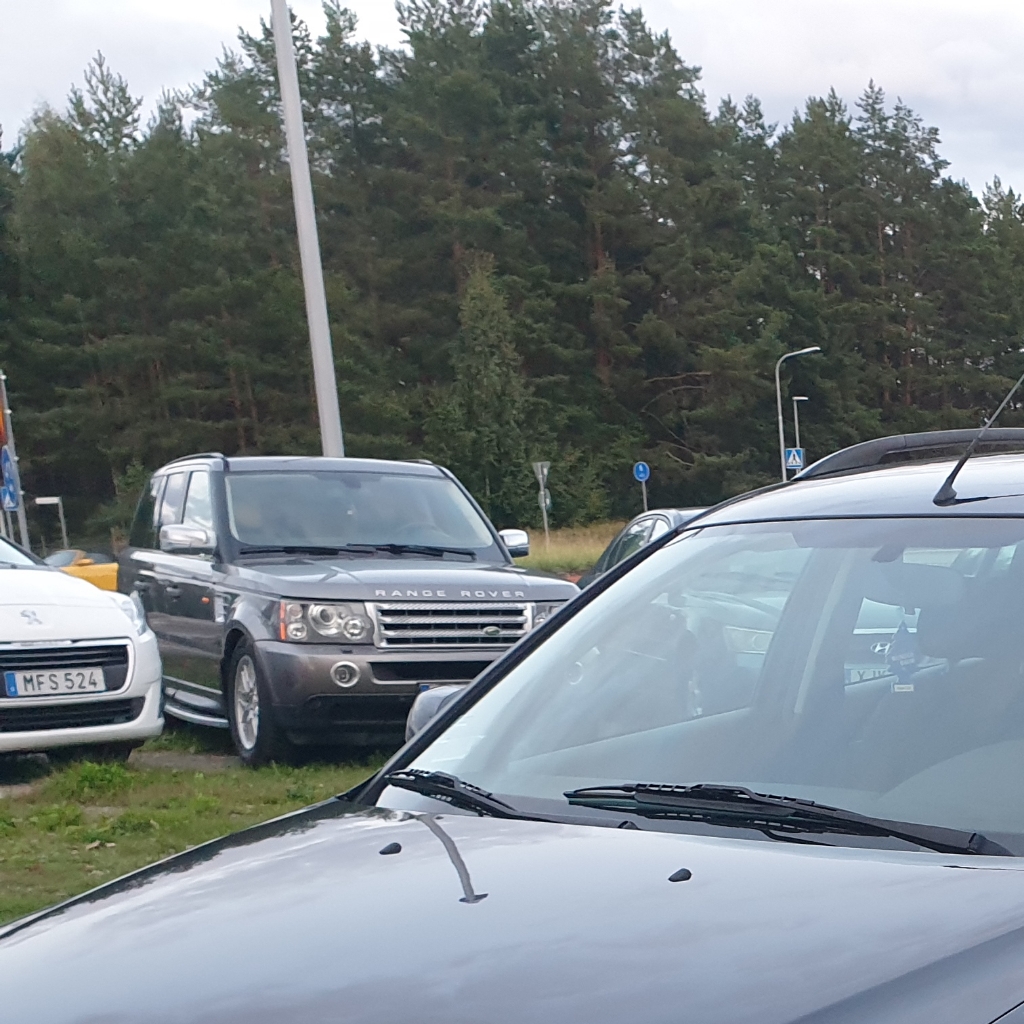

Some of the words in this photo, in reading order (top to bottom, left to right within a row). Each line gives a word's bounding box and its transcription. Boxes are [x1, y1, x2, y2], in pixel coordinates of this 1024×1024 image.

[375, 589, 447, 597] RANGE
[460, 590, 525, 598] ROVER
[23, 673, 59, 692] MFS
[64, 671, 98, 690] 524
